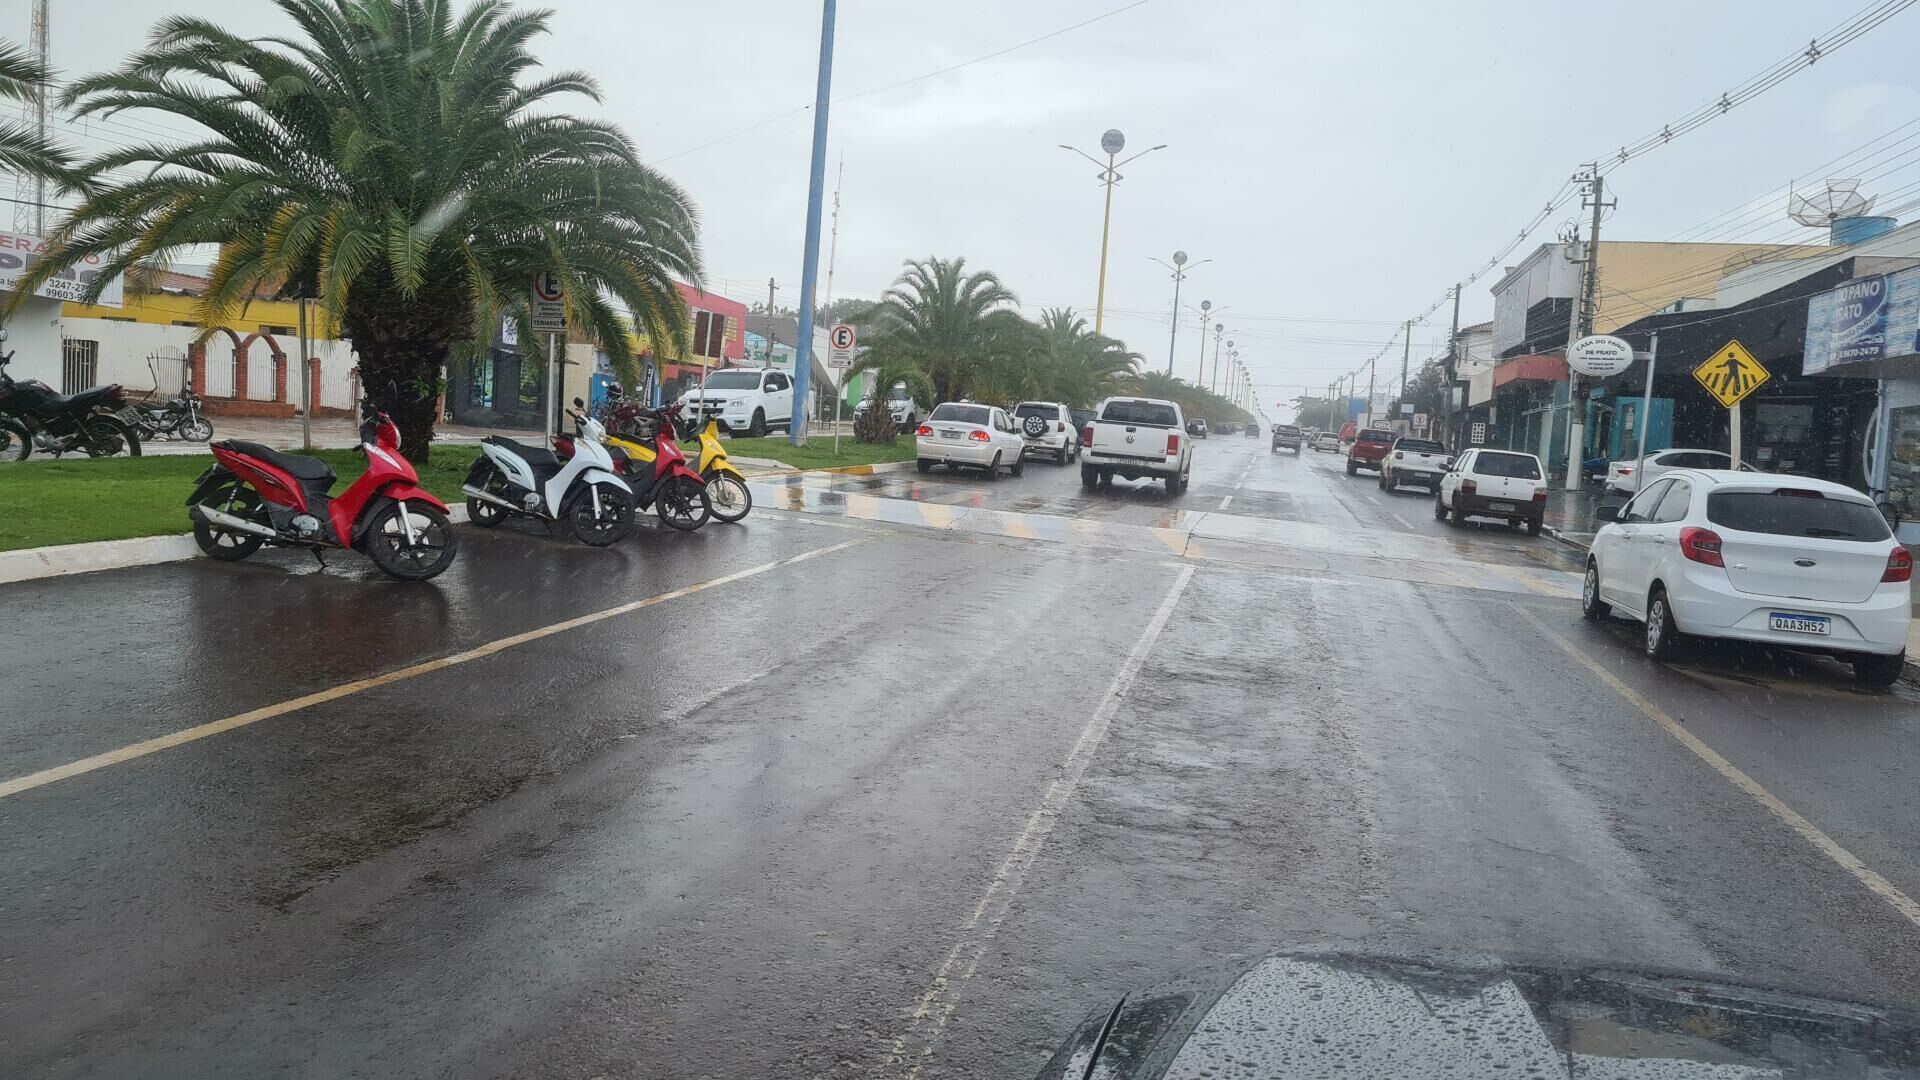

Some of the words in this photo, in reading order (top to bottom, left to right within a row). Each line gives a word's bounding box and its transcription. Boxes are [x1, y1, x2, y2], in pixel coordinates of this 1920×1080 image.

[1848, 280, 1880, 300] PANO
[838, 330, 847, 345] E
[1576, 340, 1594, 351] CASA
[1776, 618, 1824, 632] QAA3H52
